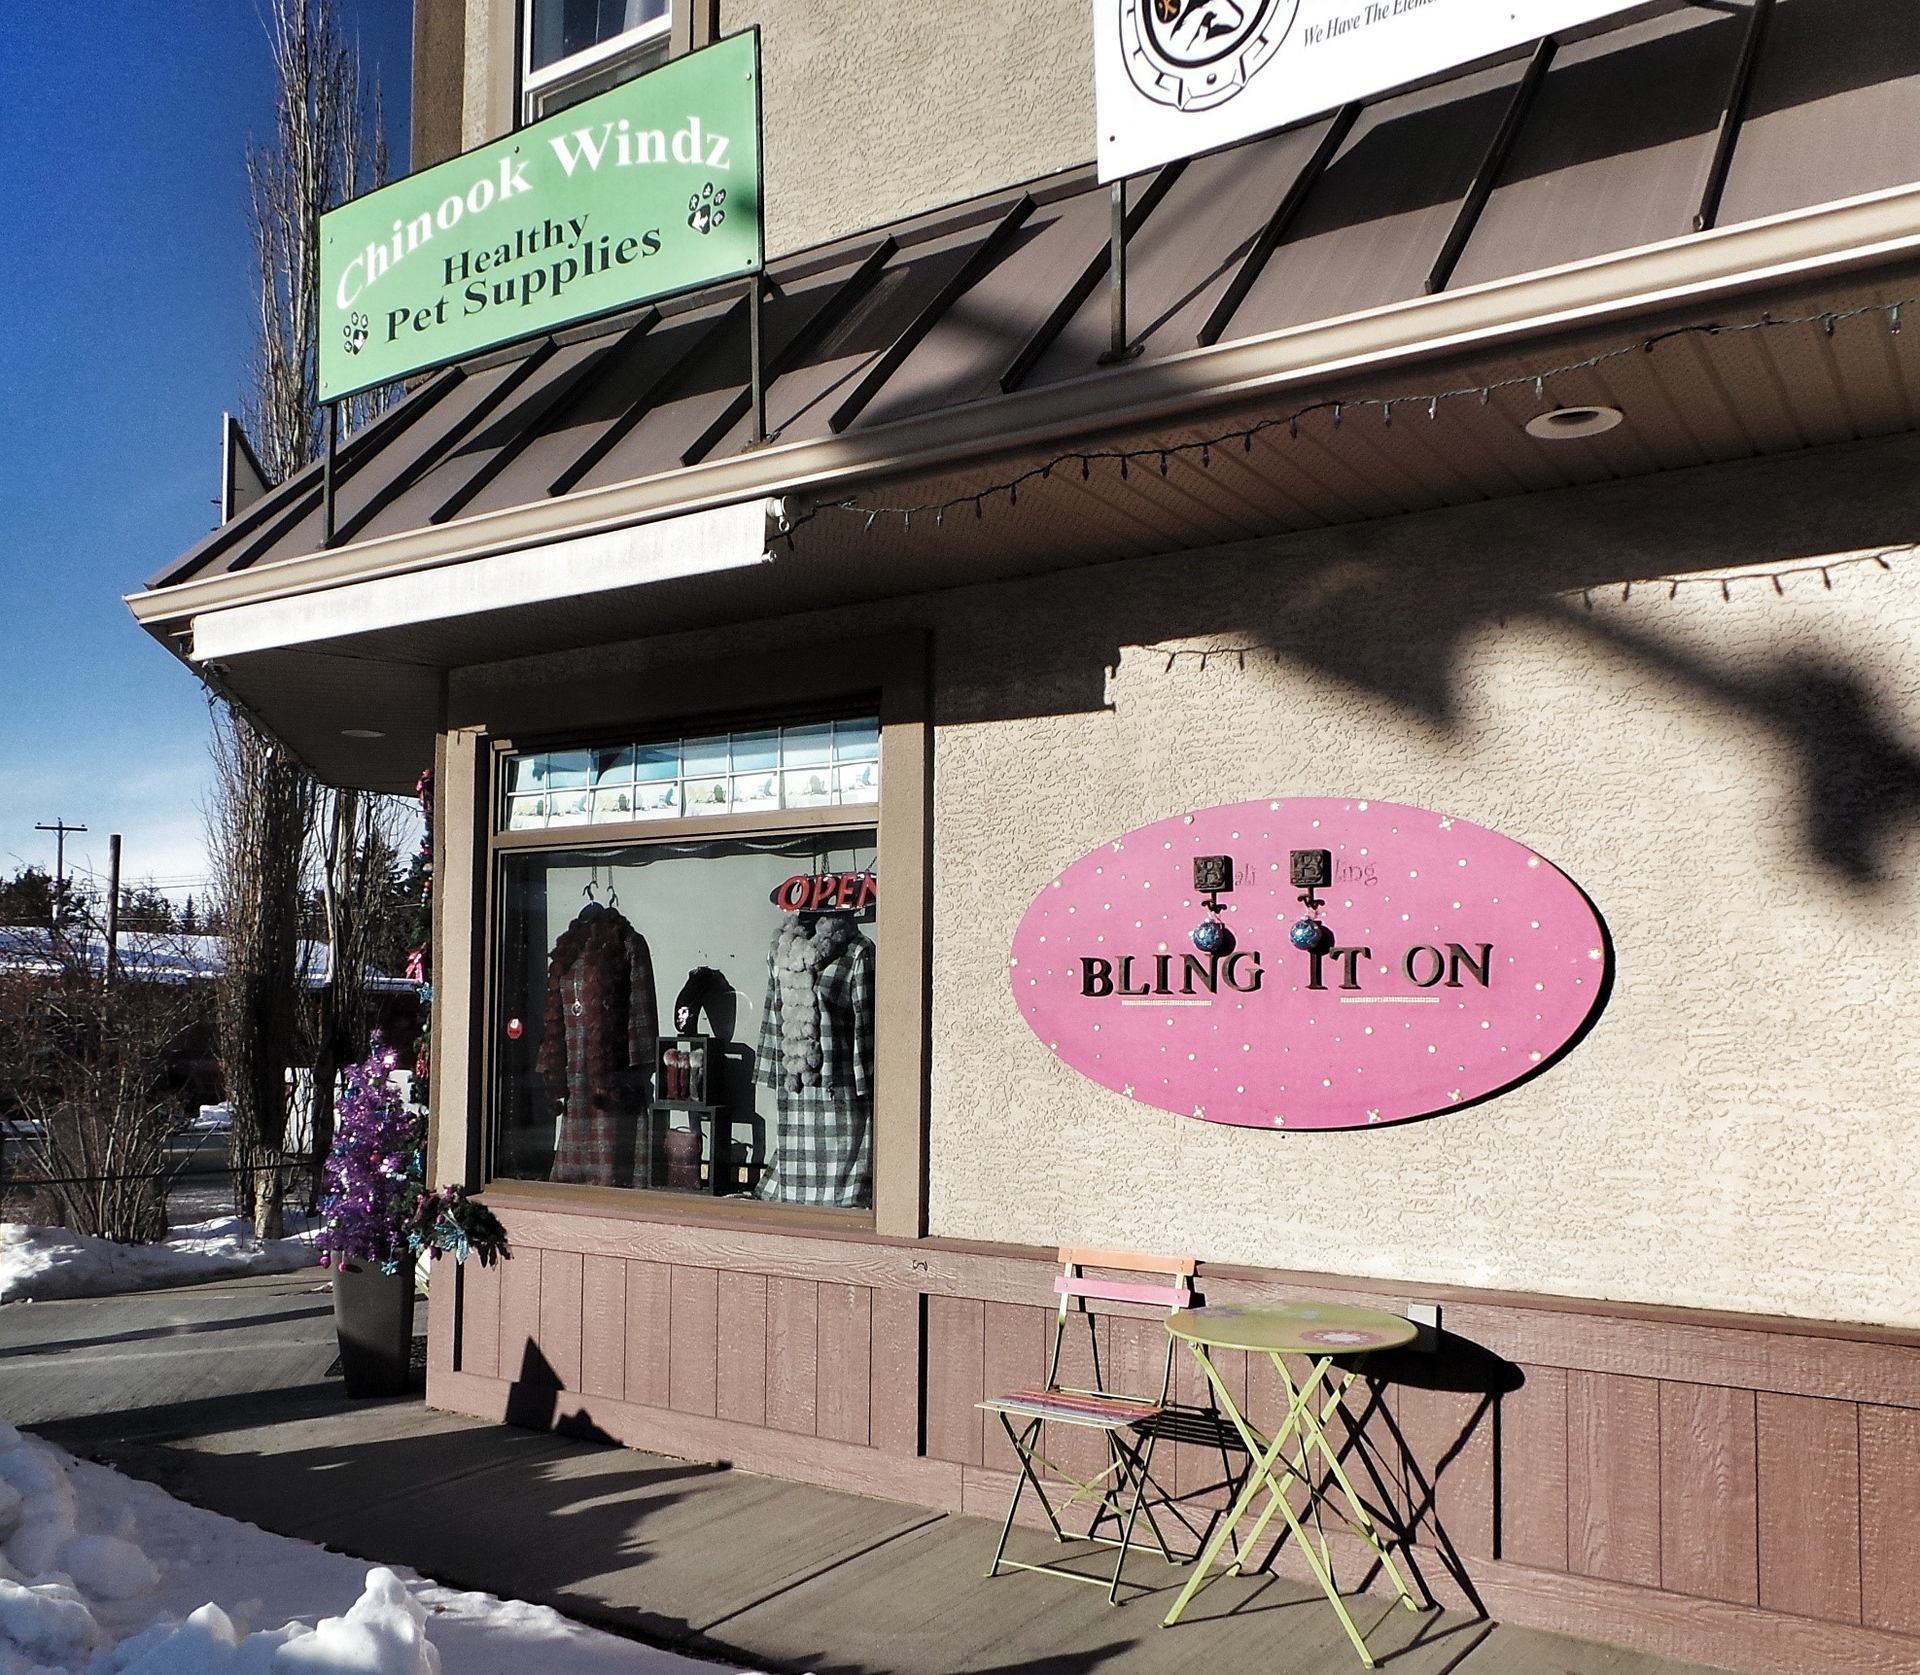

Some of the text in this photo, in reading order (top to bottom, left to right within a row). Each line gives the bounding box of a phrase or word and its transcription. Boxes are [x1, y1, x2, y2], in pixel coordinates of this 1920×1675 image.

[1304, 23, 1323, 47] We
[1326, 16, 1361, 39] Have
[1364, 2, 1390, 25] The
[335, 116, 731, 311] Chinook Windz
[442, 213, 591, 288] Healthy
[384, 227, 662, 343] Pet Supplies
[777, 872, 877, 912] OPEN
[1080, 942, 1494, 997] BLING IT ON
